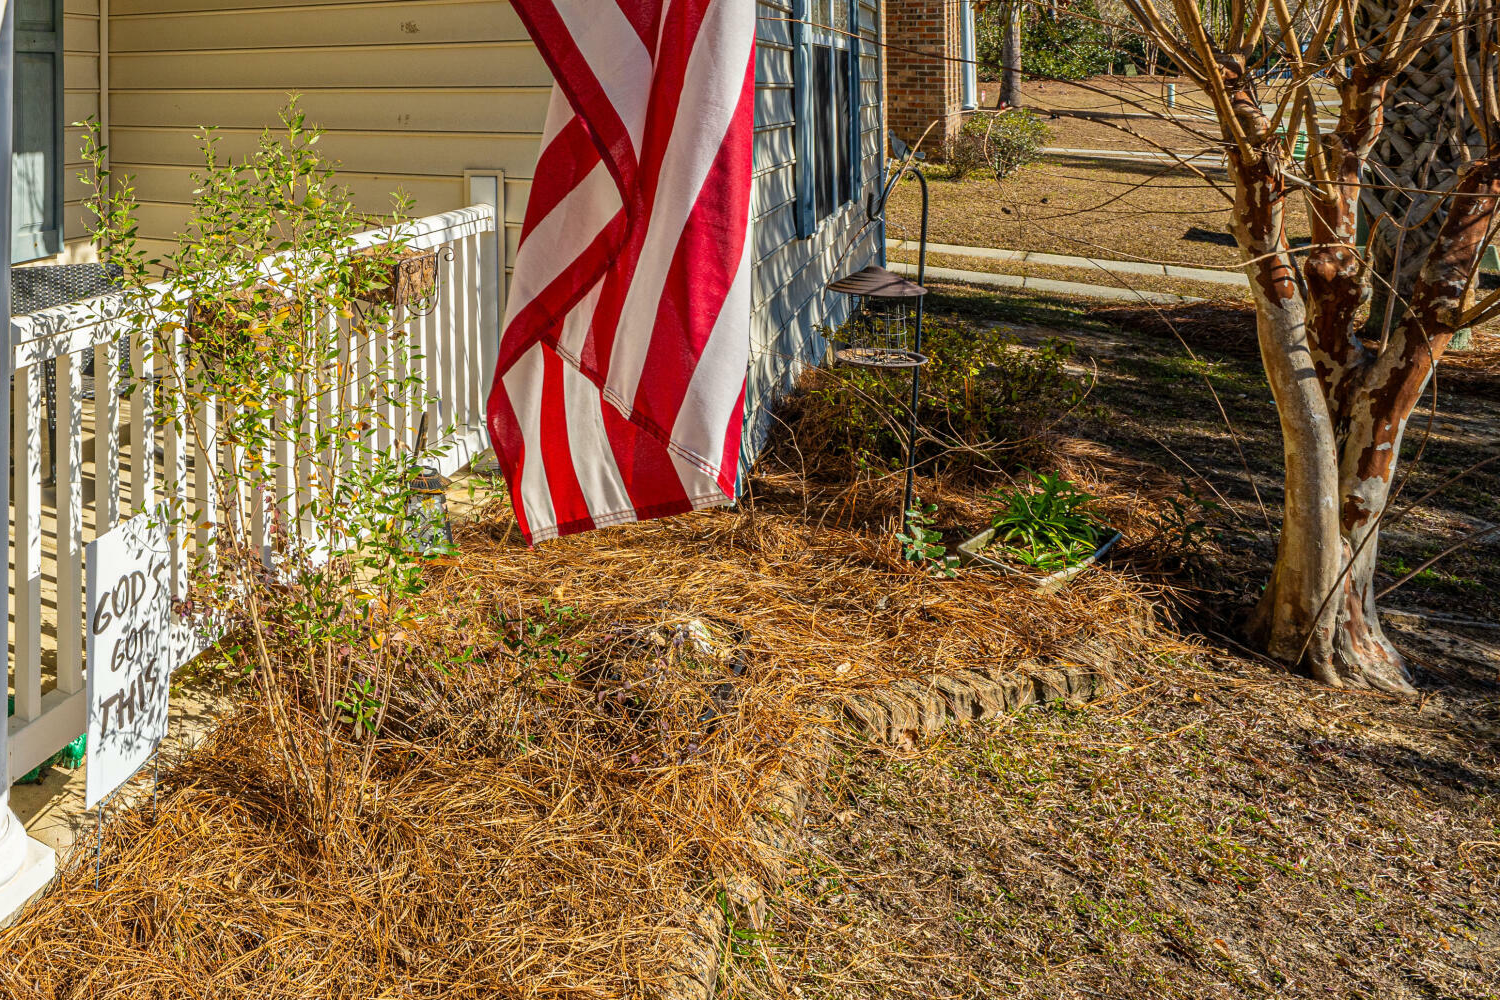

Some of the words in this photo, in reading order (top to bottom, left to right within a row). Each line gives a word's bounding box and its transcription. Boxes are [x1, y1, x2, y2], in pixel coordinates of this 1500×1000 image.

[92, 561, 166, 636] GOD'S
[110, 620, 150, 673] GOT
[100, 657, 158, 738] THIS
